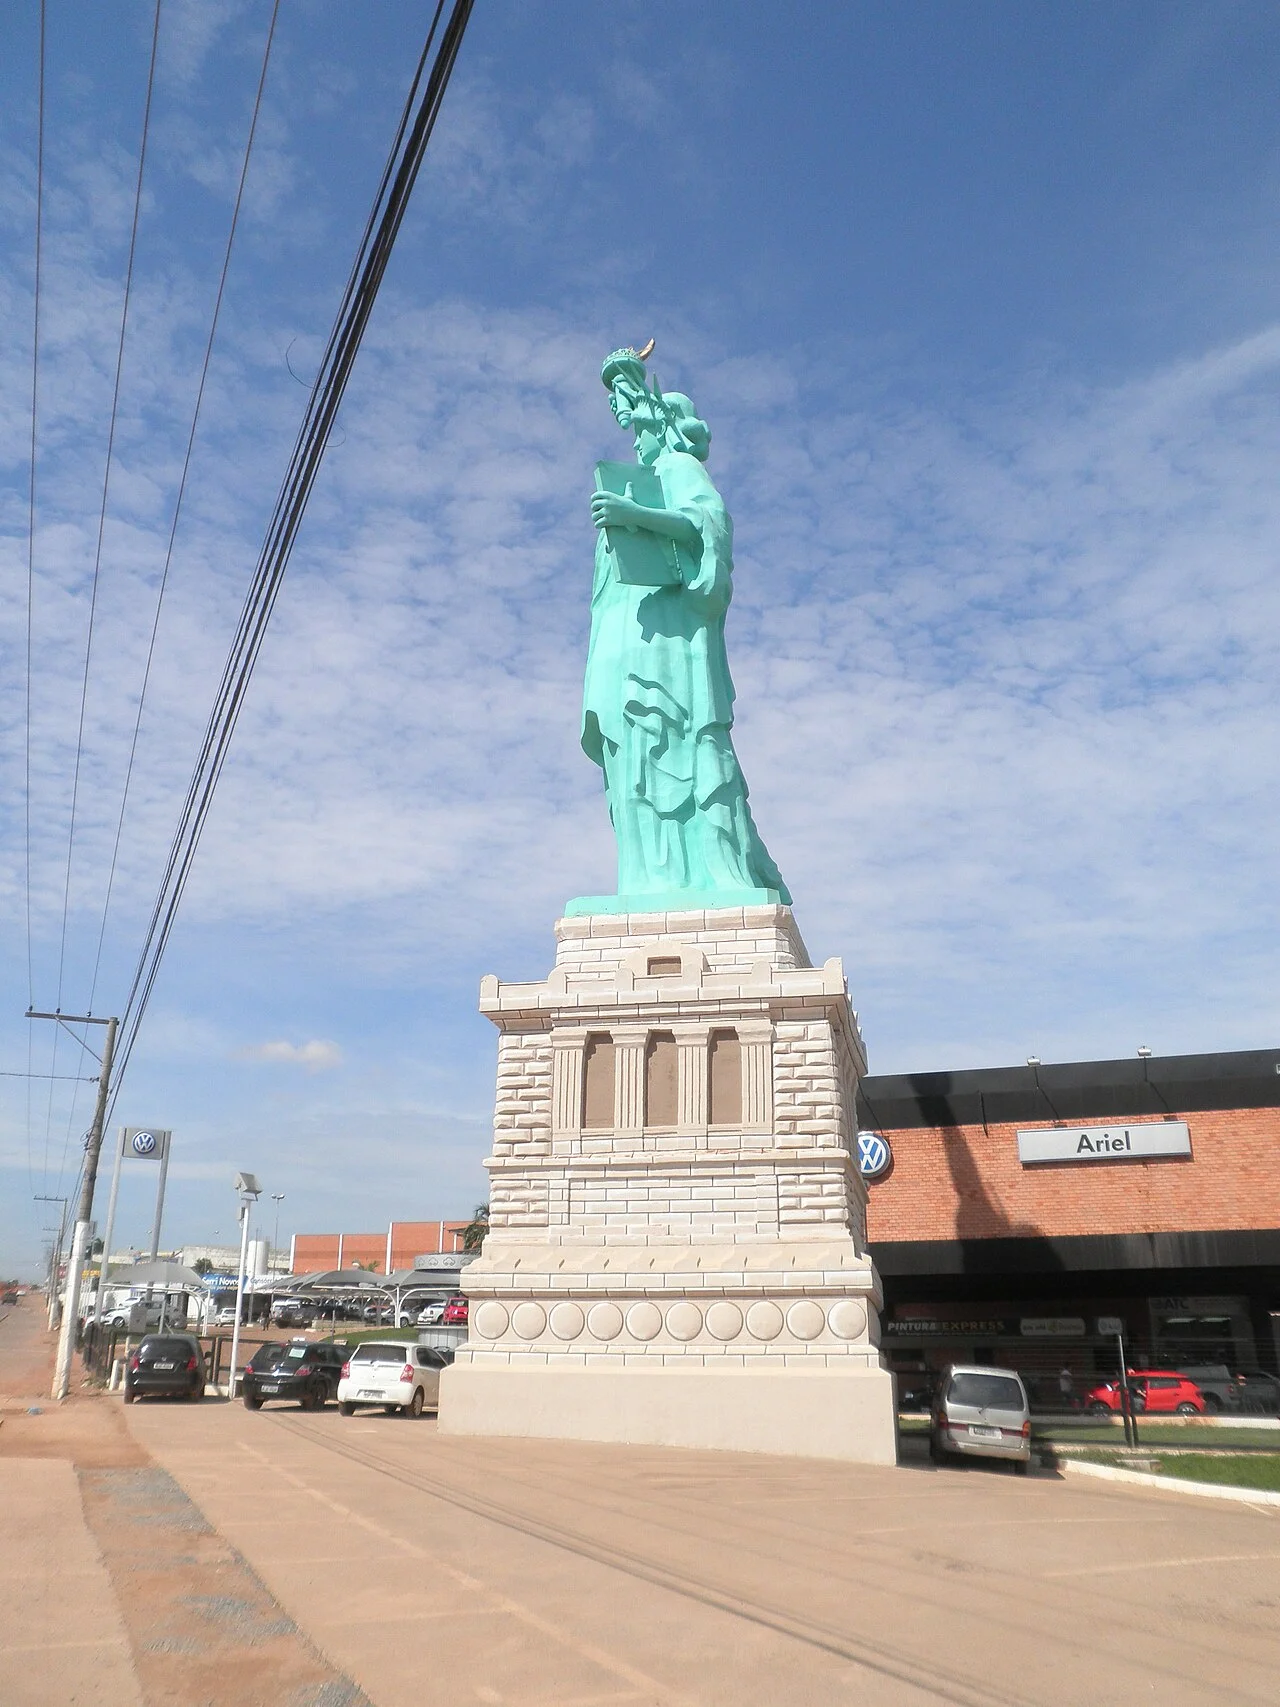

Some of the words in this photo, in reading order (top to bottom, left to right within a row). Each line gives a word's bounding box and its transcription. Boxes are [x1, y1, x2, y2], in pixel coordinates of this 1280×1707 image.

[1076, 1130, 1131, 1154] Ariel
[887, 1321, 936, 1331] PINTURA
[942, 1320, 1005, 1331] EXPRESS
